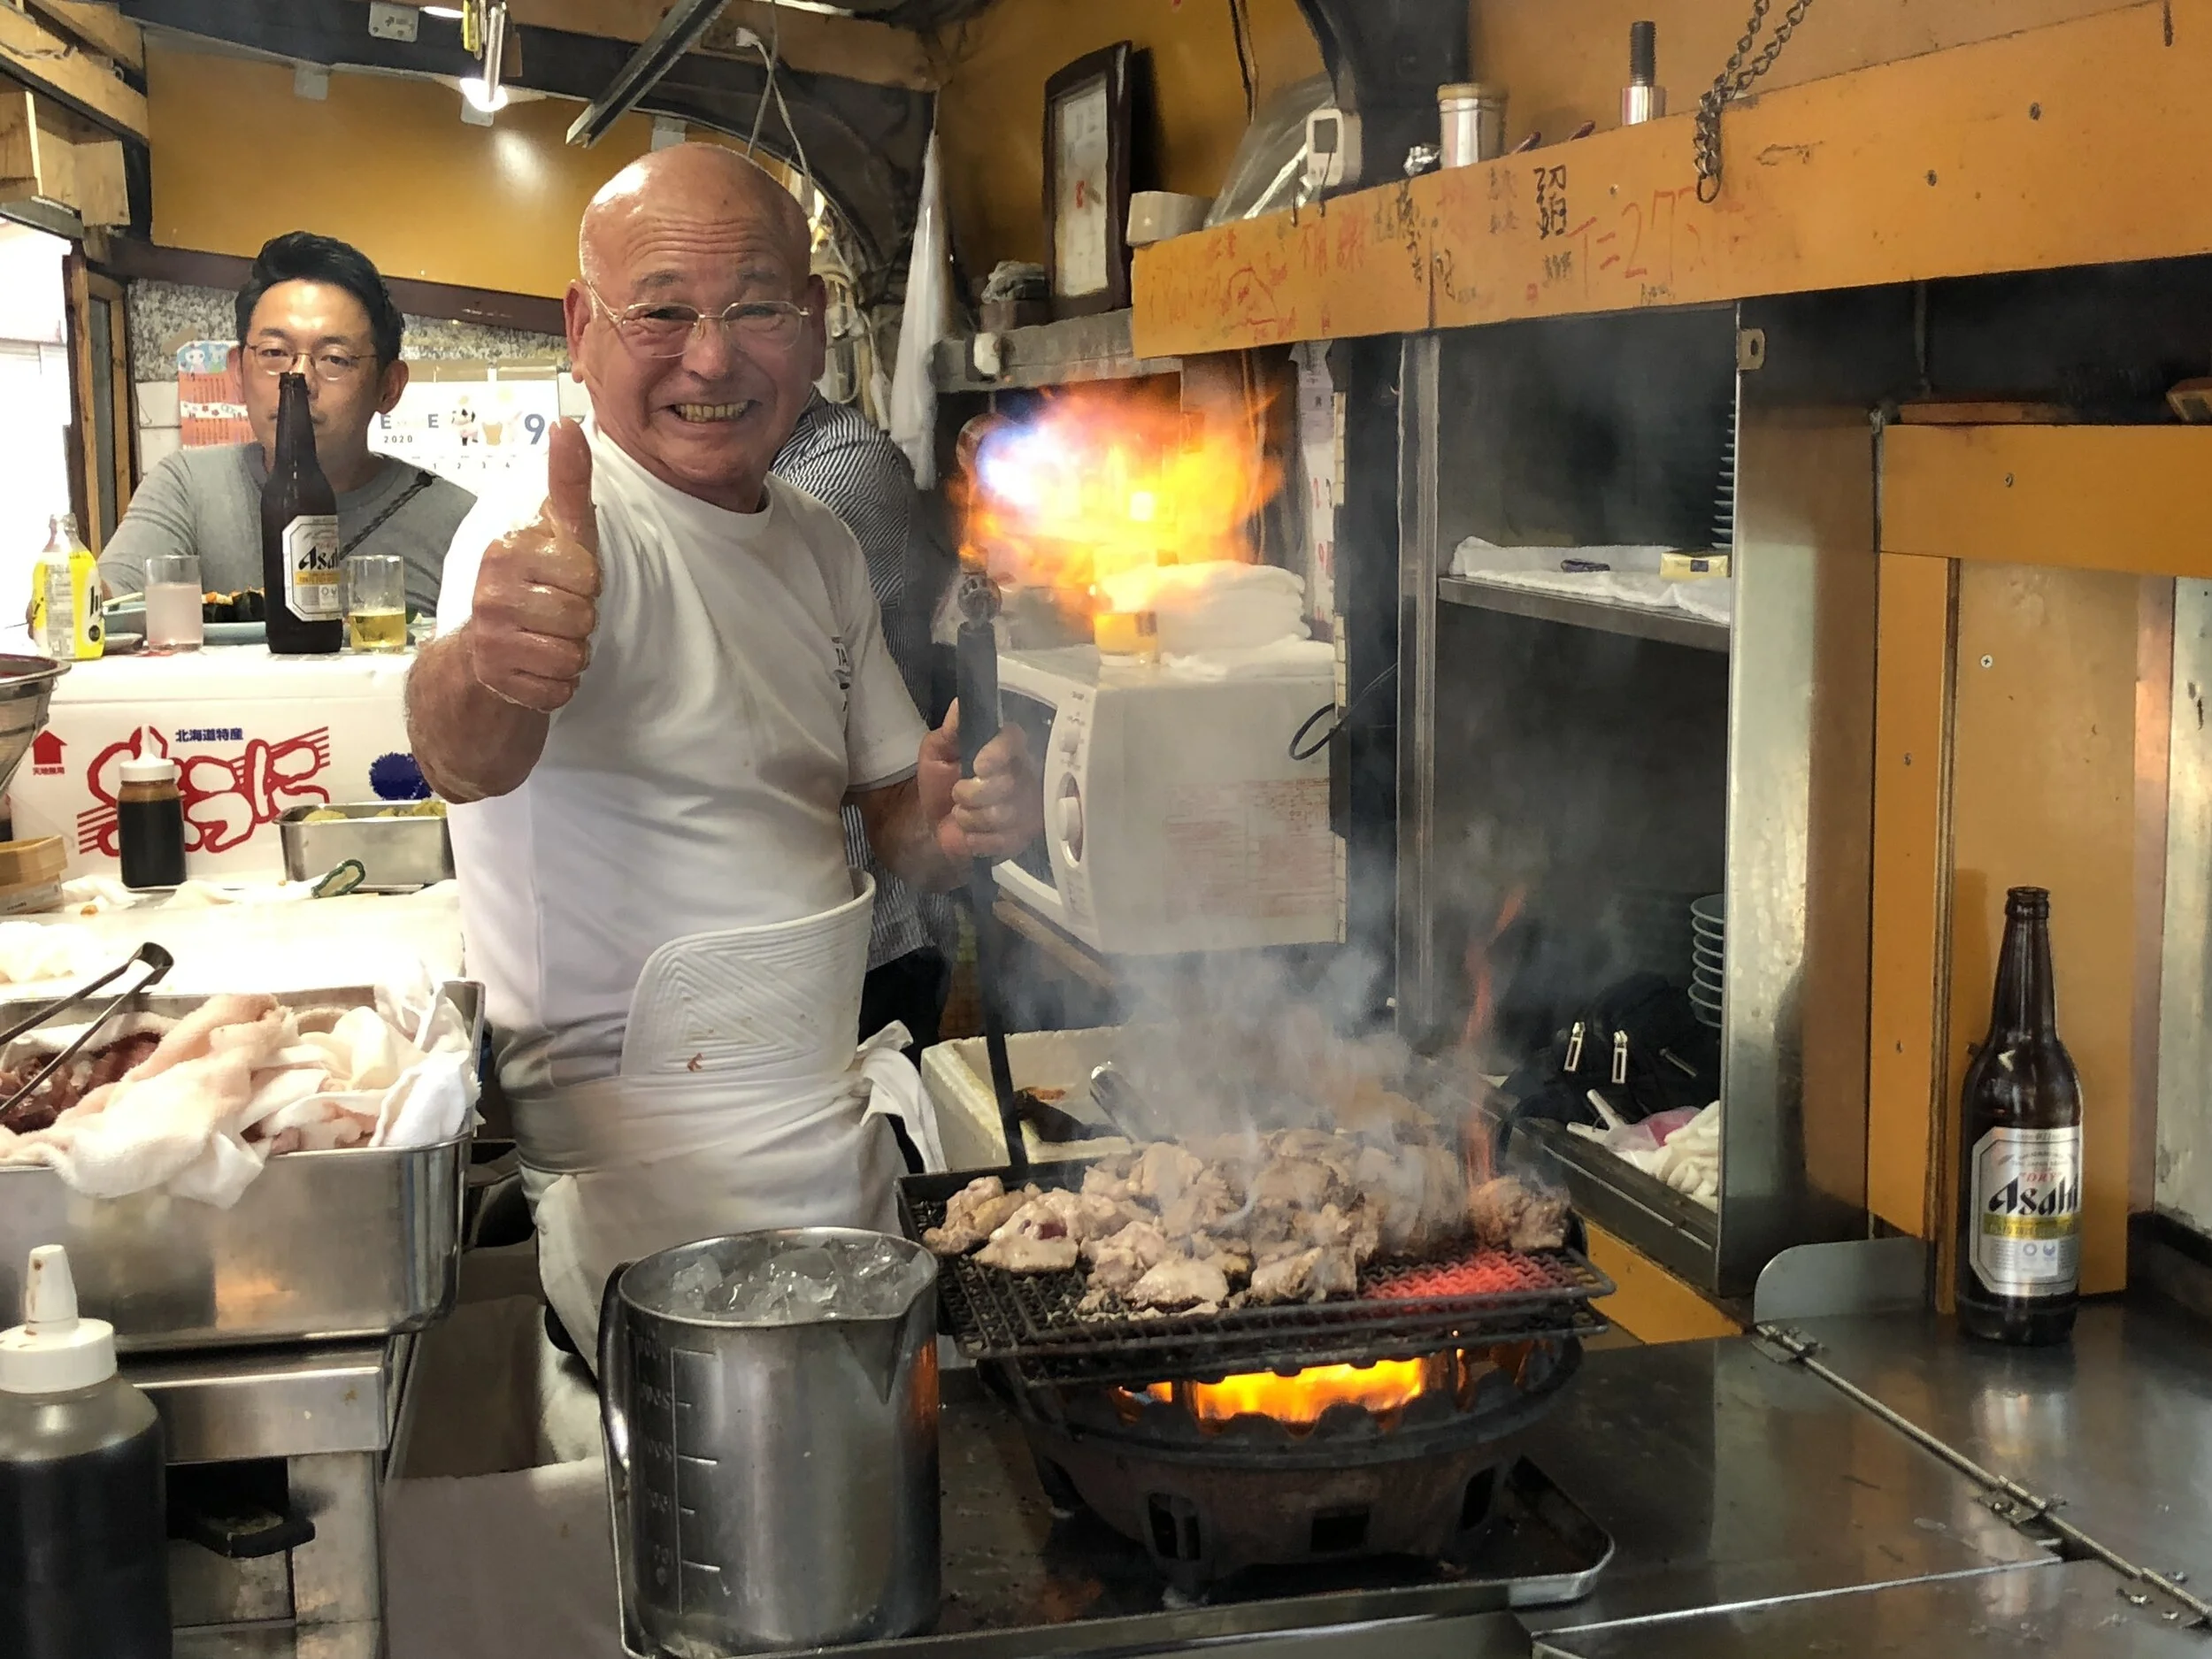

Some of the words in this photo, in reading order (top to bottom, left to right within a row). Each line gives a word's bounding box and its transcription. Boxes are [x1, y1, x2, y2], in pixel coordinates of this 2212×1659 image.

[384, 434, 413, 444] 2020
[524, 413, 546, 446] 9
[175, 727, 244, 742] 北海道特産
[1988, 1172, 2079, 1216] Asahi
